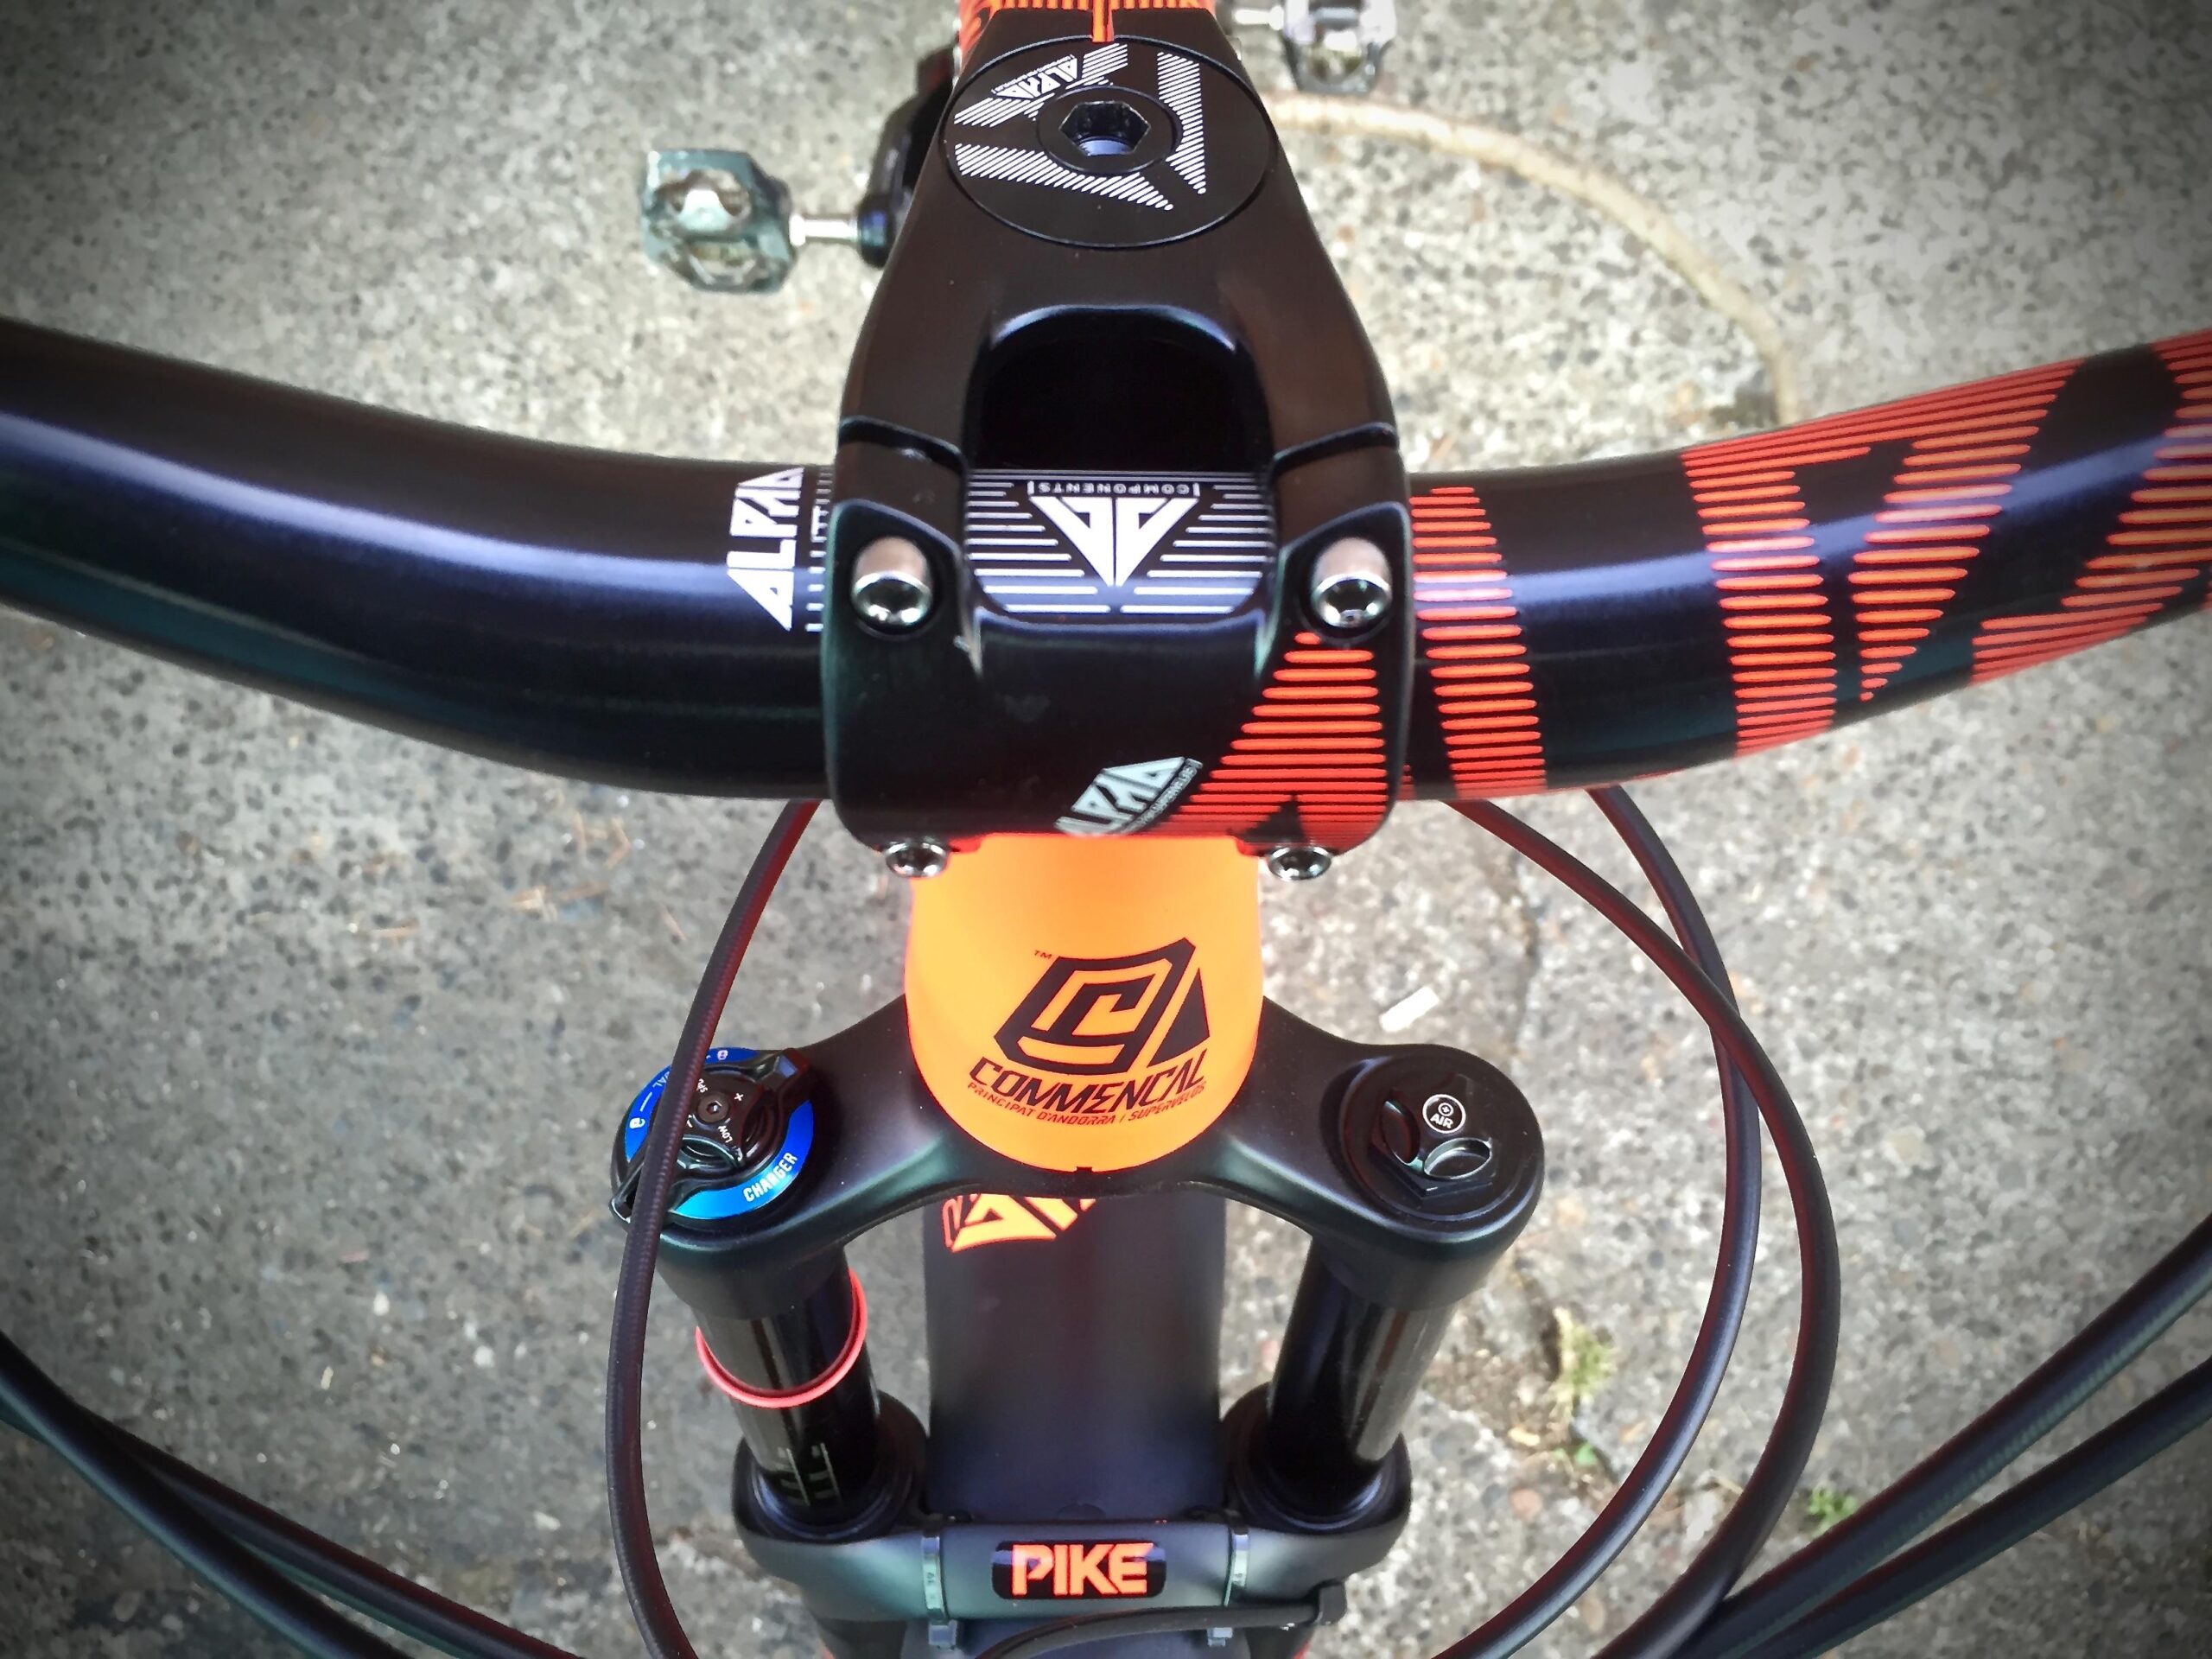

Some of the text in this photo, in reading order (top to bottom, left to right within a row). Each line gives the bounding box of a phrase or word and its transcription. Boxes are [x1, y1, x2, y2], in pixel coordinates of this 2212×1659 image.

[1038, 481, 1191, 496] COMPONENTS
[969, 1047, 1207, 1115] COMMENCAL
[967, 1082, 1035, 1117] PRINCIPAT
[1037, 1111, 1116, 1125] D'ANDORRA
[1429, 1113, 1454, 1129] AIR
[717, 1125, 734, 1143] LOW
[743, 1153, 798, 1202] CHARGER
[1012, 1542, 1154, 1596] PIKE
